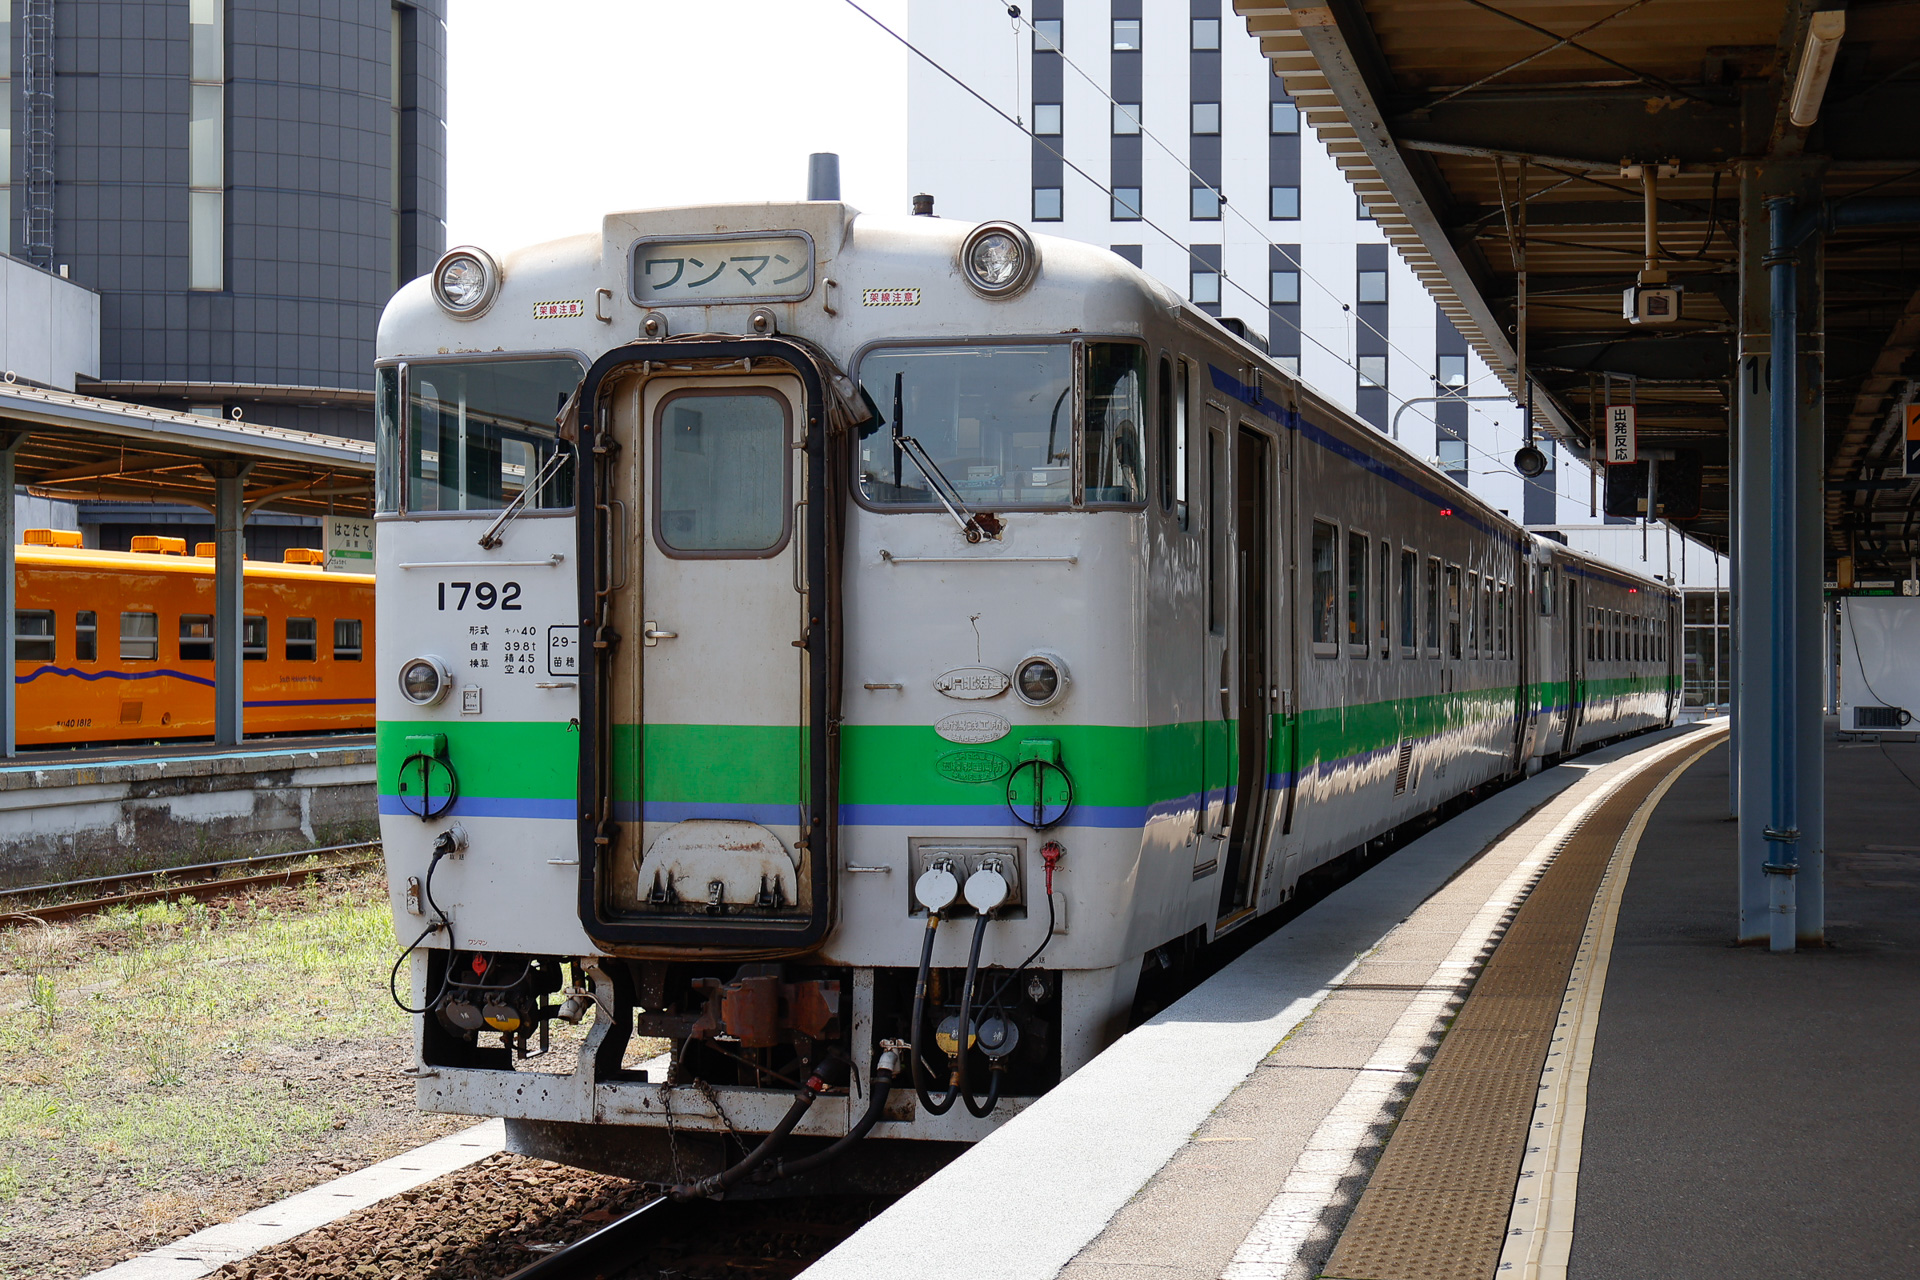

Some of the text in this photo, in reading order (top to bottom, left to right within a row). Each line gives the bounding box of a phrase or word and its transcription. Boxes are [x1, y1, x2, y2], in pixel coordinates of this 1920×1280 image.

[645, 254, 809, 290] ワンマン
[870, 292, 913, 302] 架線注意
[540, 304, 577, 315] 架線注意
[1746, 356, 1772, 395] 1
[1614, 408, 1628, 460] 出発反応
[334, 522, 369, 538] はこだて
[437, 581, 522, 611] 1792
[469, 625, 537, 636] 形式 キハ40
[470, 641, 537, 652] 自重 39.8t
[518, 653, 535, 663] 4.5
[553, 656, 575, 668] 苗穂
[504, 664, 535, 674] 空 4.0
[76, 718, 92, 727] 1812
